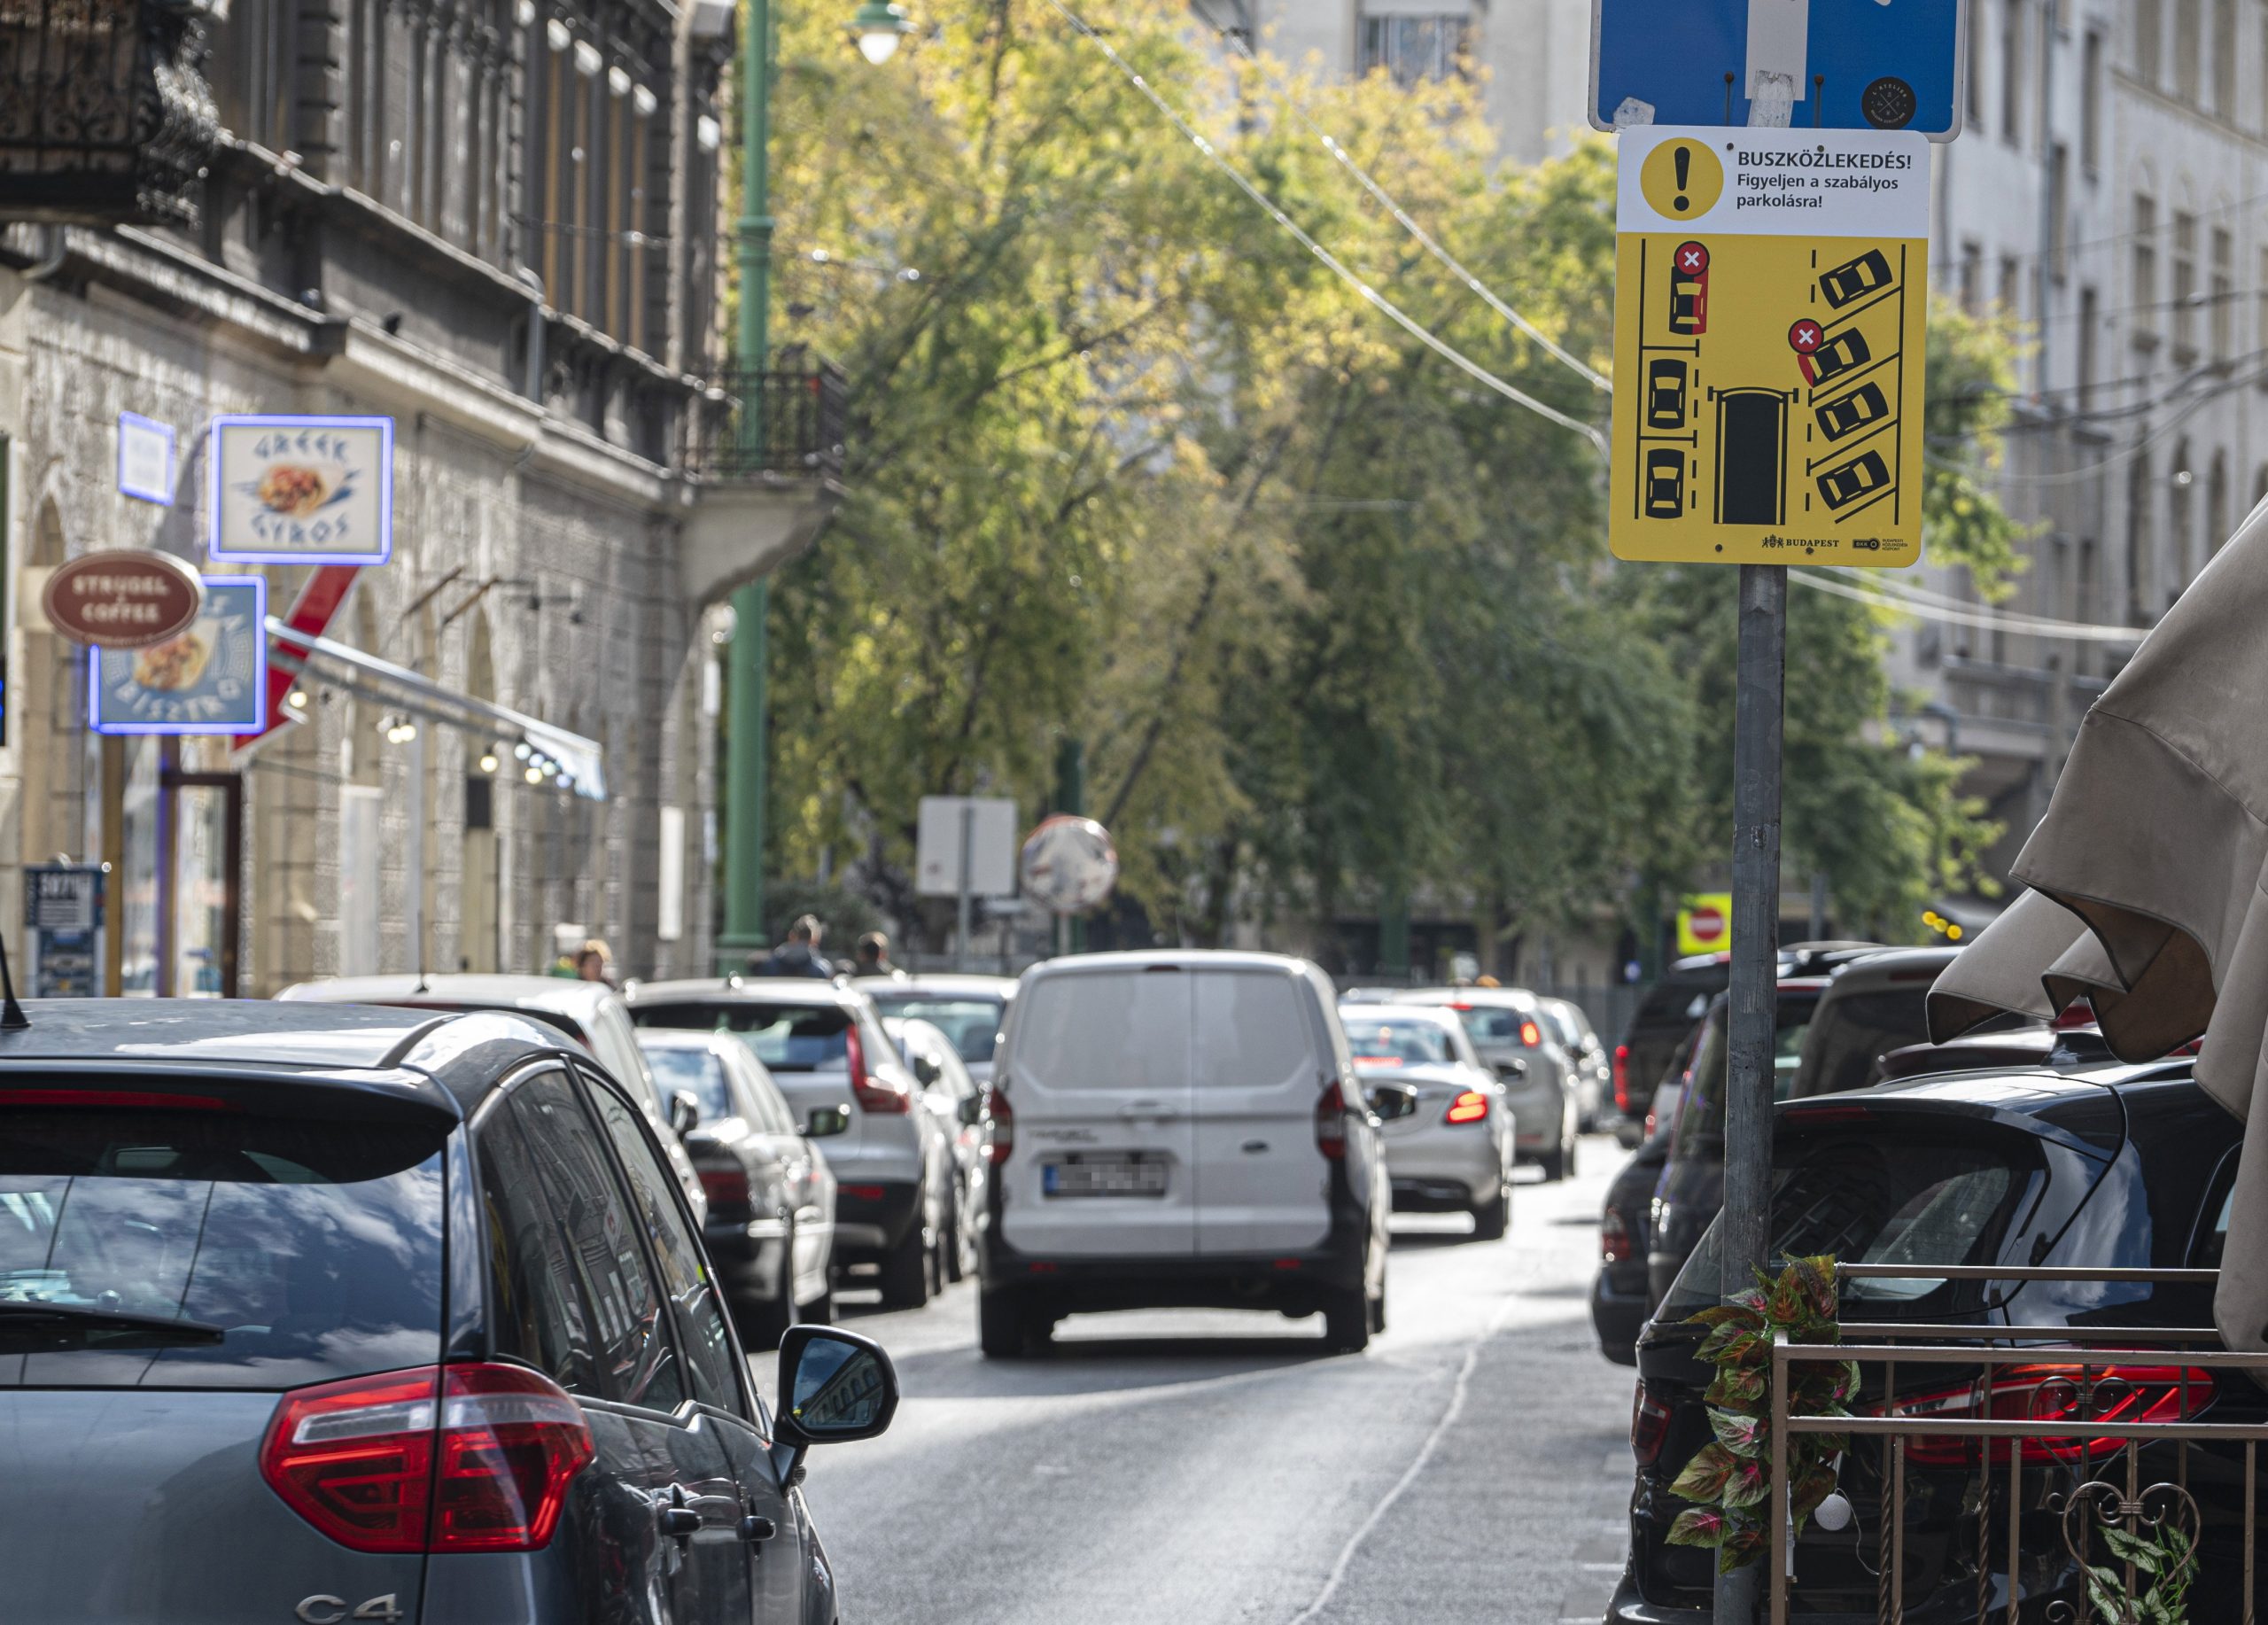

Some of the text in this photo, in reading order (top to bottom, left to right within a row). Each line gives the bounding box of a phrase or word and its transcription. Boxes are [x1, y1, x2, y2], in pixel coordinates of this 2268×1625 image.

[1738, 149, 1912, 169] BUSZKÖZLEKEDÉS!
[1737, 173, 1899, 193] Figyeljen a szabályos
[1736, 193, 1822, 210] parkolásra!
[254, 430, 348, 462] GREEK
[251, 510, 349, 546] GYROS
[1786, 539, 1840, 548] BUDAPEST
[72, 575, 171, 595] STRUDEL
[81, 603, 160, 624] COFFEE
[295, 1593, 404, 1624] C4
